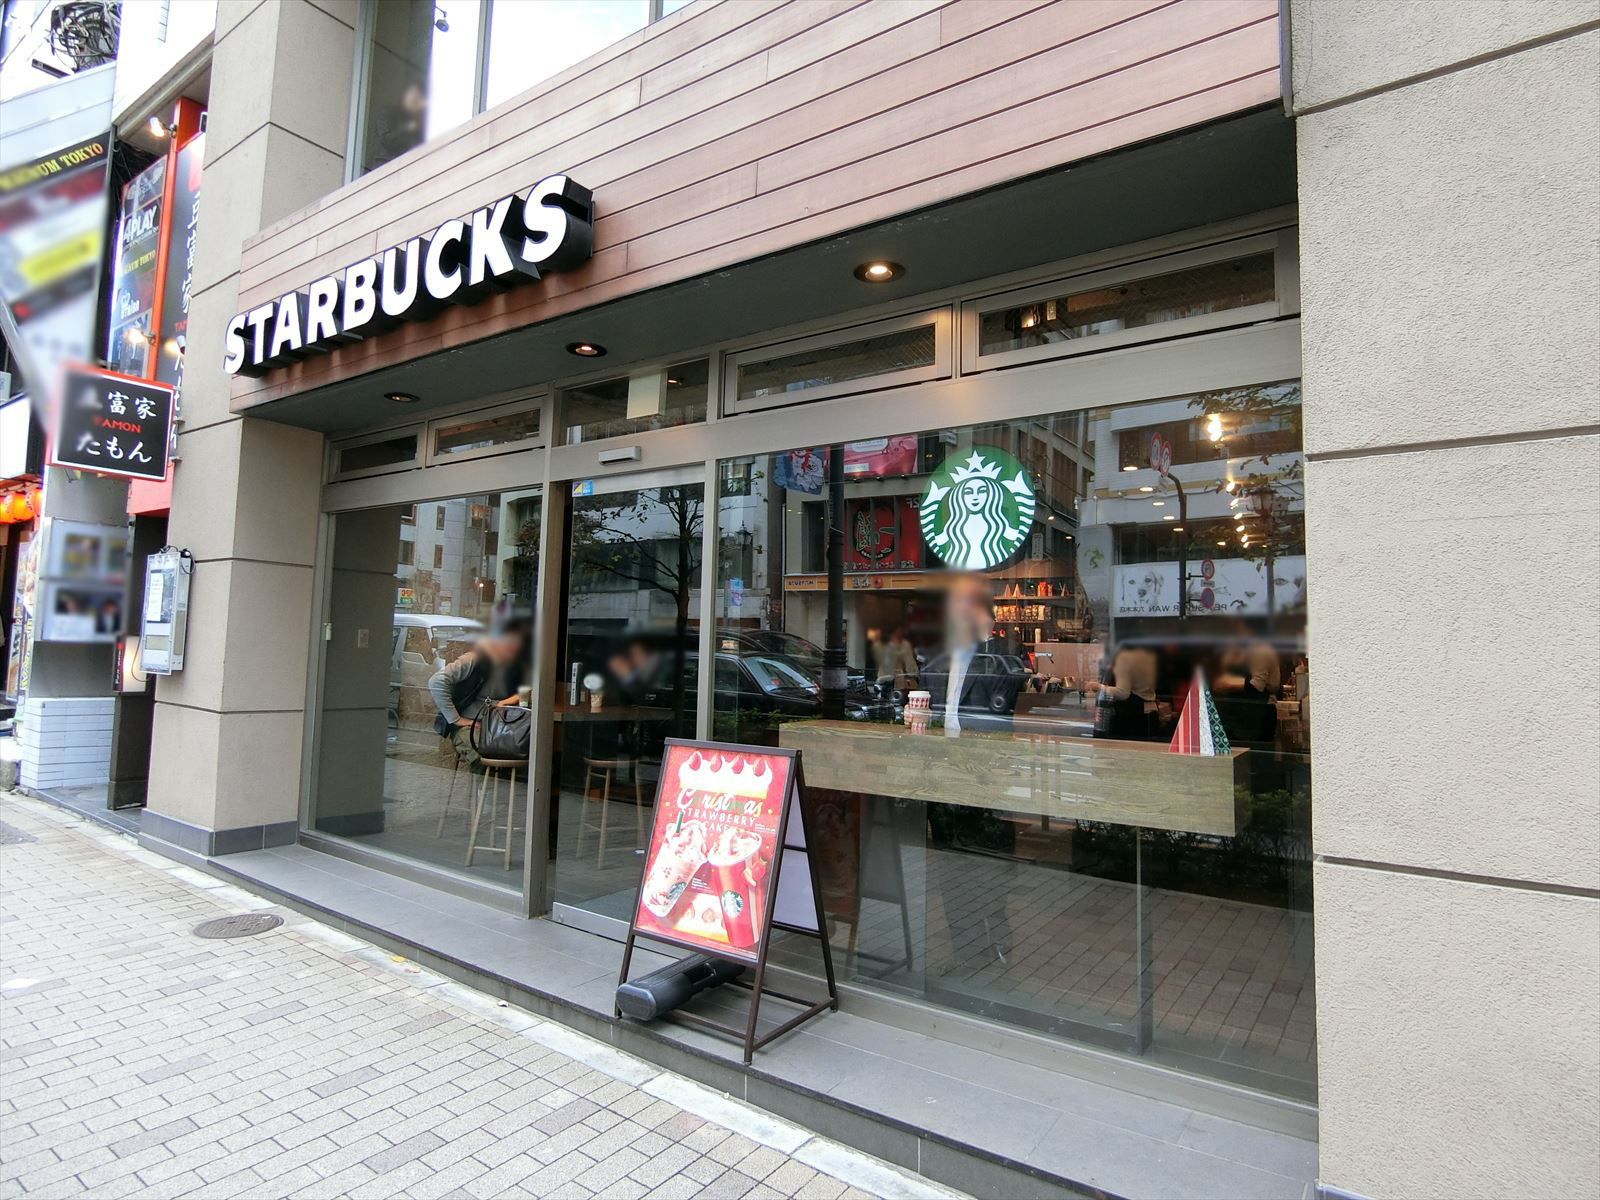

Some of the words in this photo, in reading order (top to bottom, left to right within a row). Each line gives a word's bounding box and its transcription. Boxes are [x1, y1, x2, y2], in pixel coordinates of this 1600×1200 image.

[59, 142, 104, 167] TOKYO
[223, 173, 567, 375] STARBUCKS
[92, 415, 142, 433] AMON
[76, 430, 153, 463] たもん
[682, 808, 756, 827] STRAWBERRY
